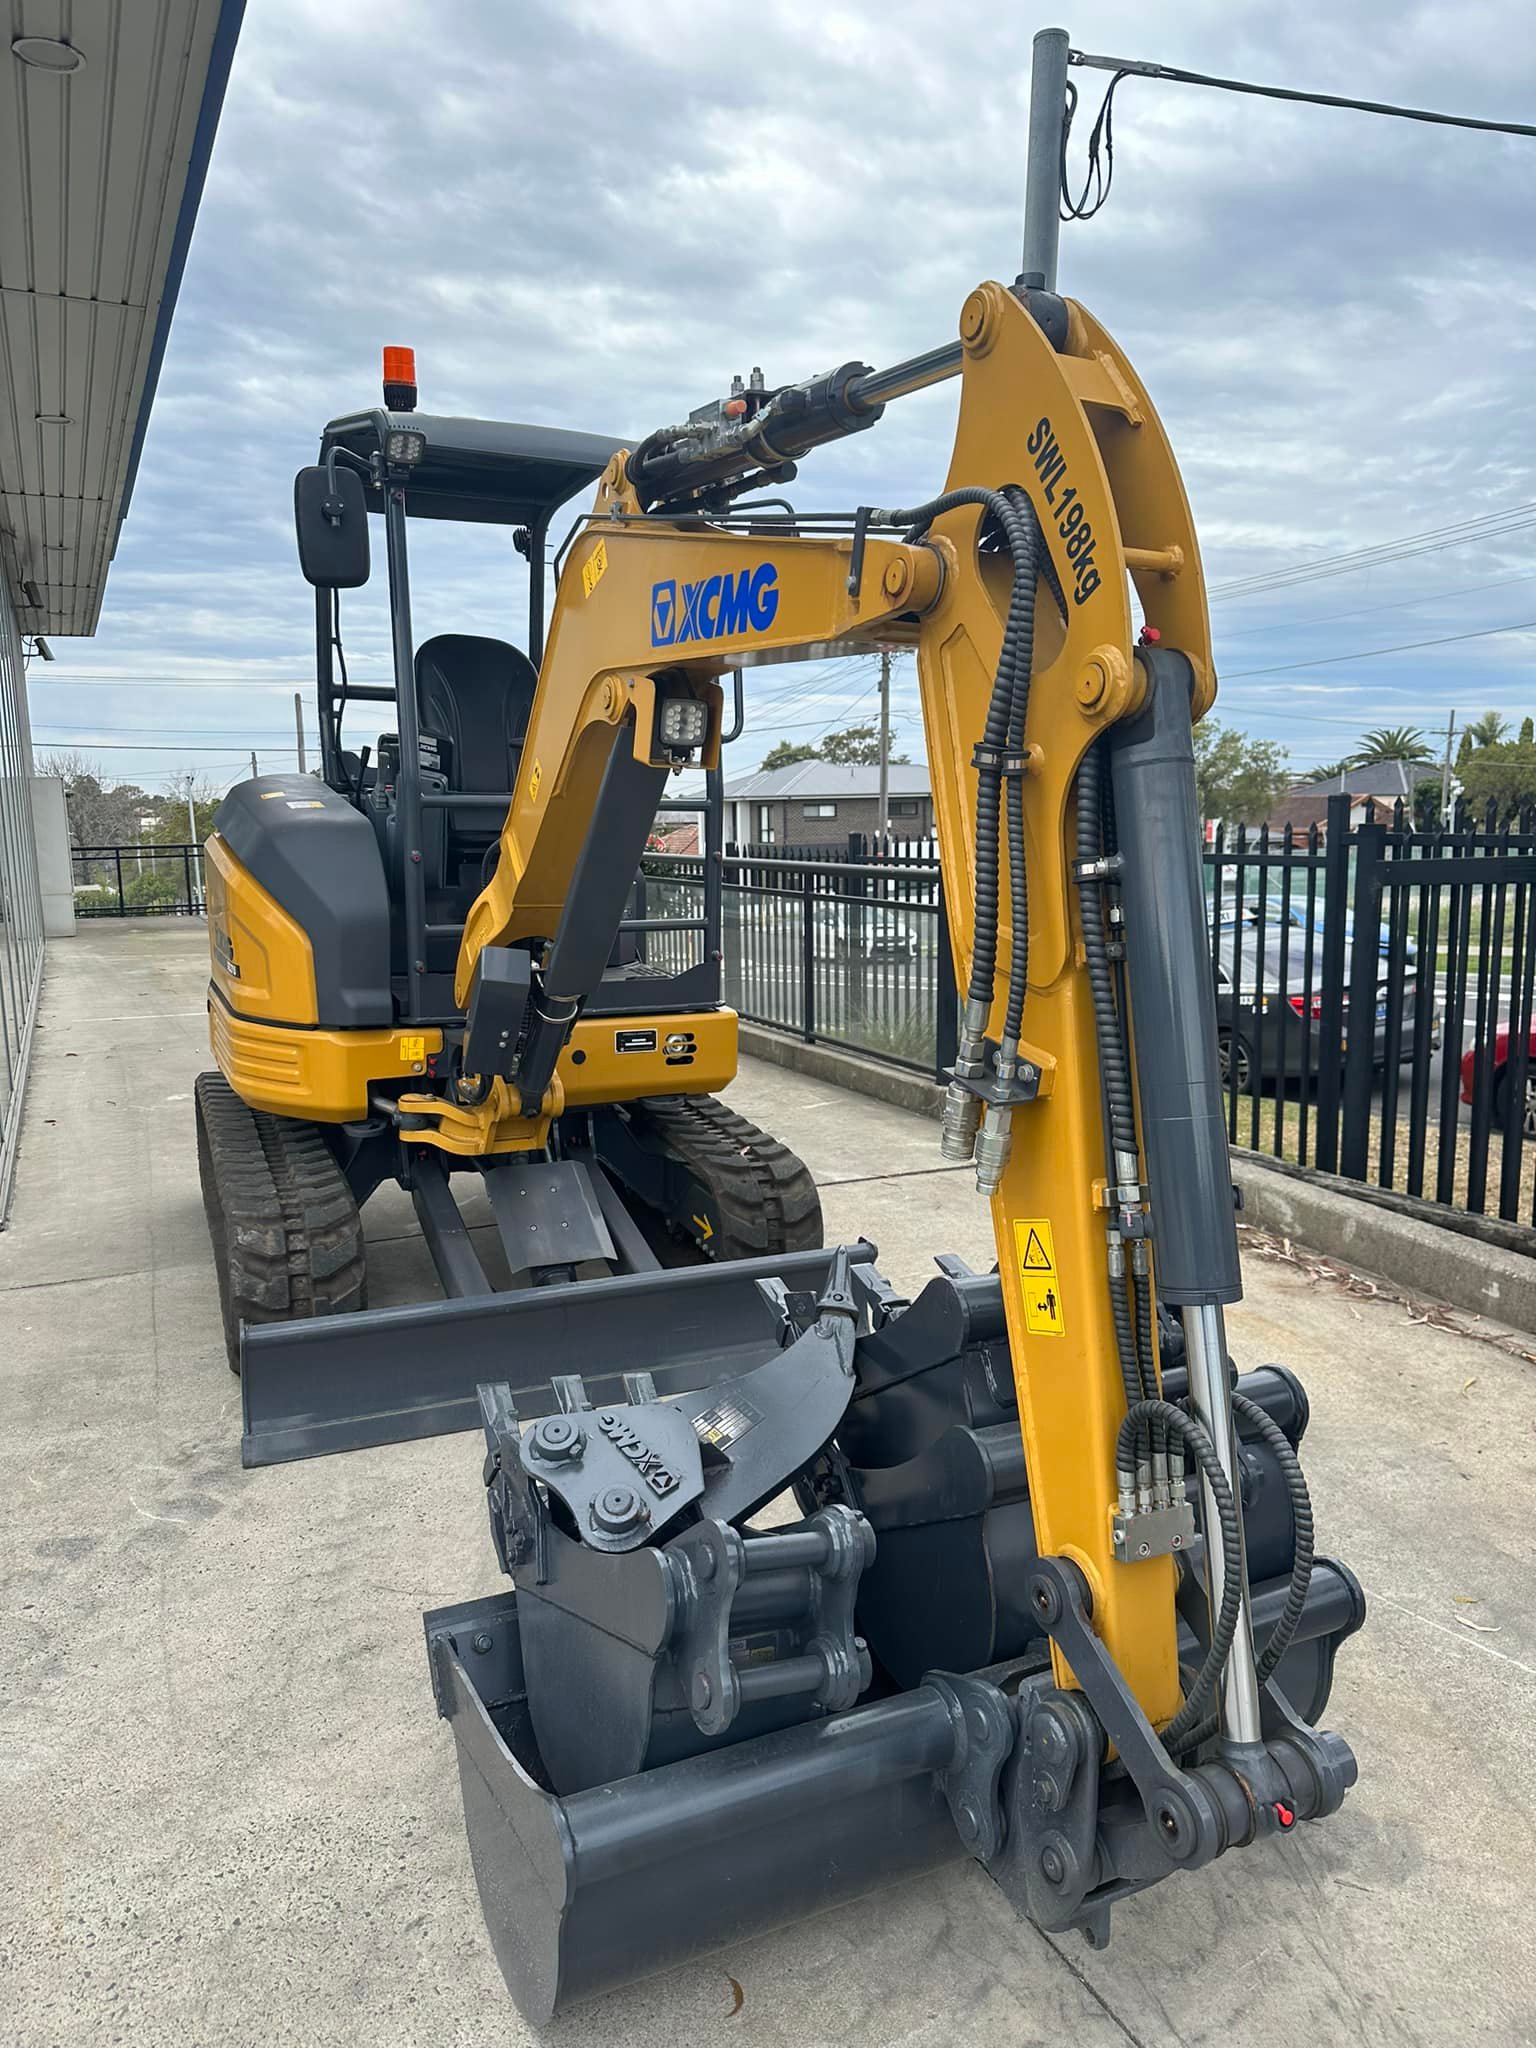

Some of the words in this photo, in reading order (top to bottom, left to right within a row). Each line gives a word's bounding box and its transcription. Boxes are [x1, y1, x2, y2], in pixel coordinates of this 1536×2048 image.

[675, 562, 779, 644] XCMG
[1207, 911, 1230, 922] TXI
[598, 1414, 665, 1476] XCMG
